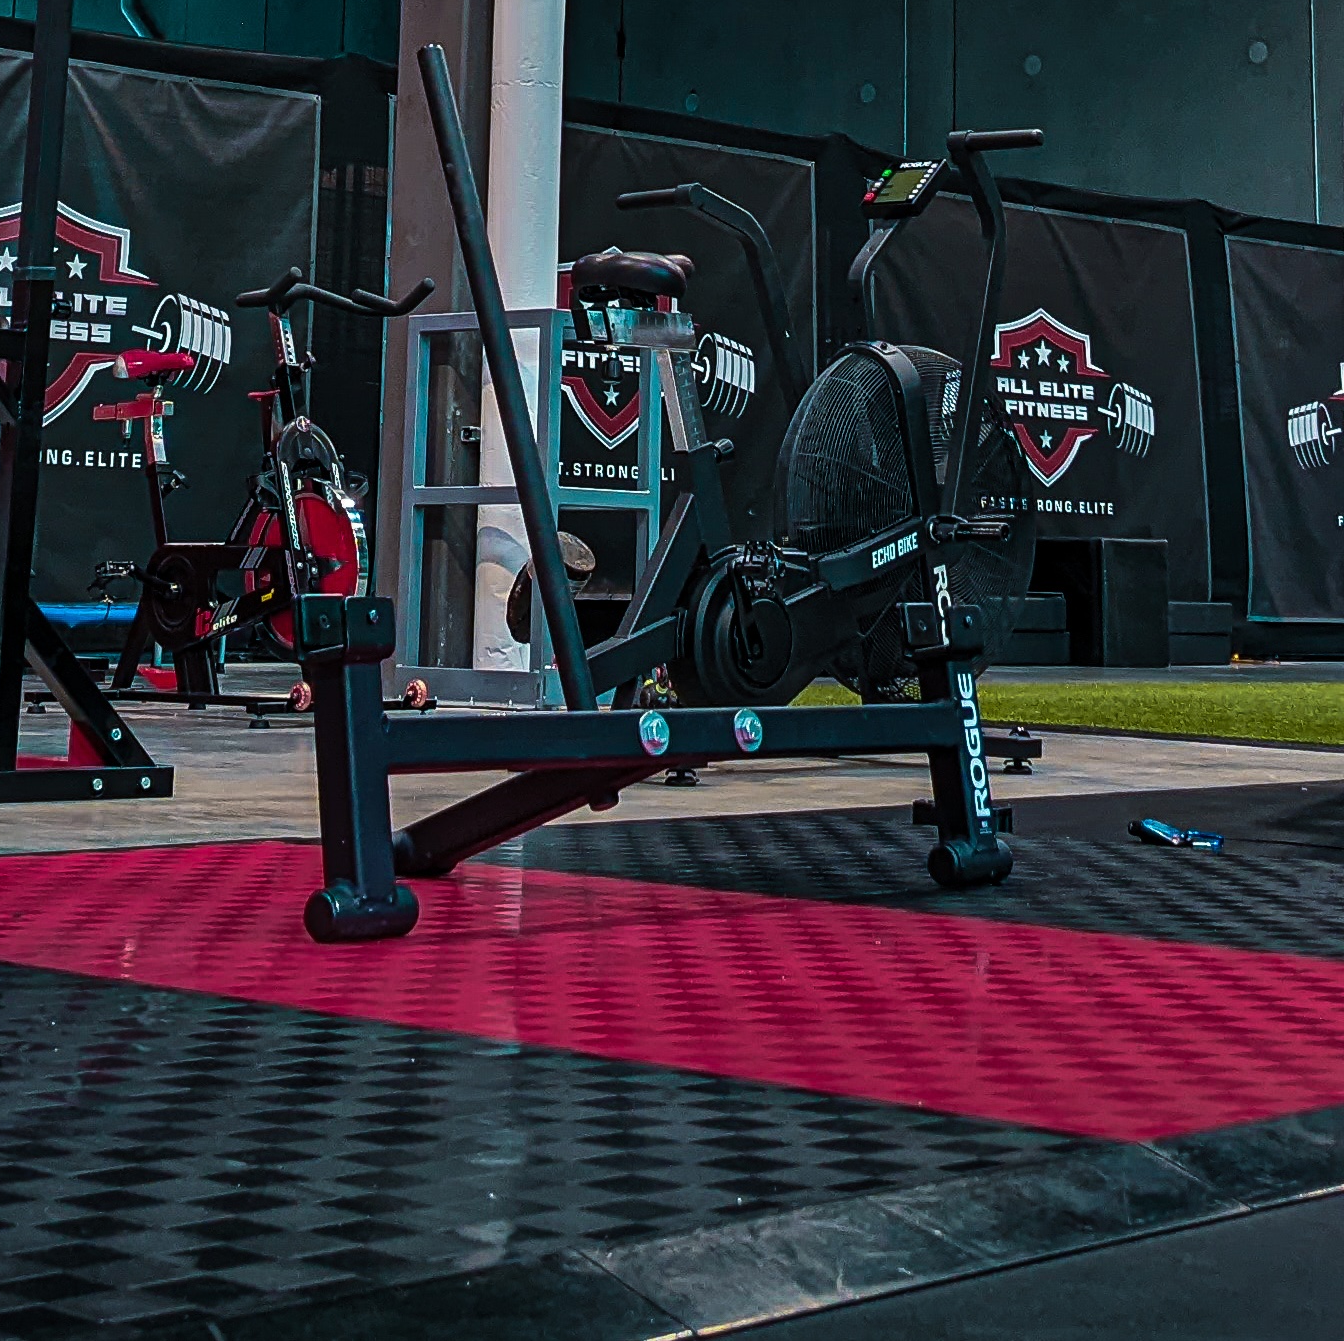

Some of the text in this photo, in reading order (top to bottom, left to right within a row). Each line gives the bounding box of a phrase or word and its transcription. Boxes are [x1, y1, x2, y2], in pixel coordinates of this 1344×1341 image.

[54, 292, 128, 316] ITE
[996, 376, 1096, 401] ALL ELITE
[1004, 399, 1088, 421] FITNESS
[871, 531, 918, 569] ECHO BIKE
[212, 614, 238, 631] elite
[957, 672, 991, 818] ROGUE
